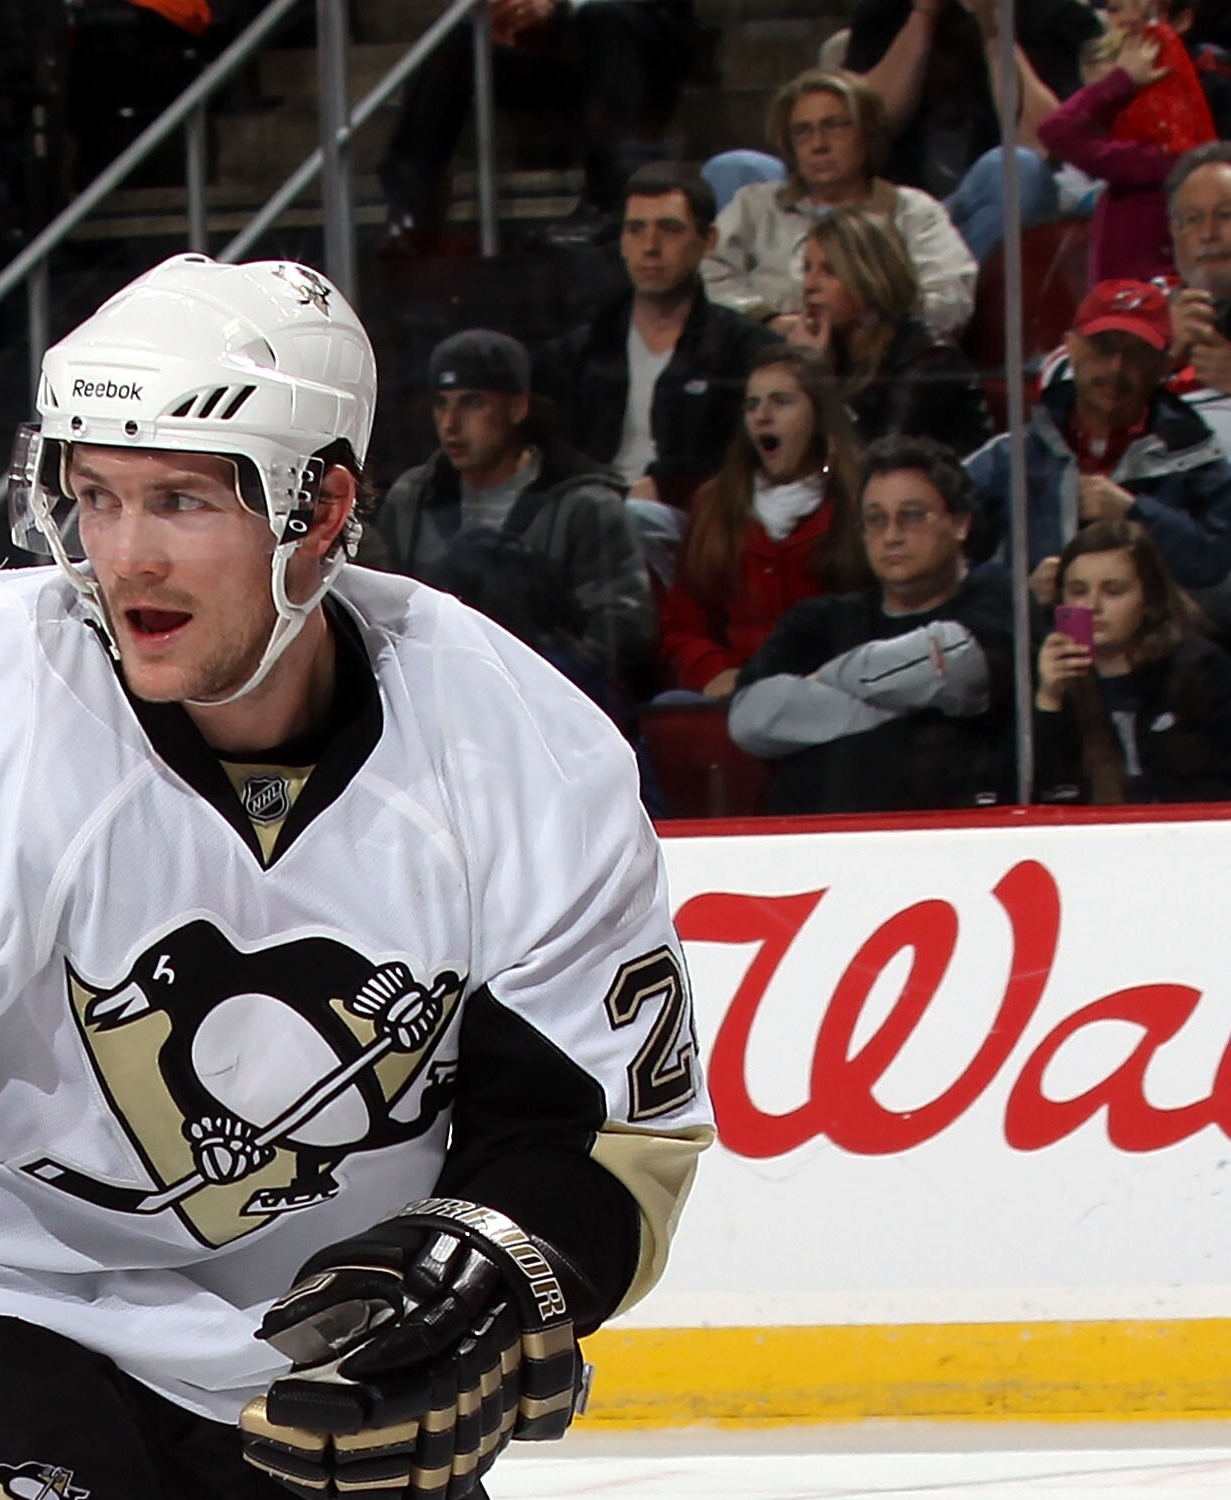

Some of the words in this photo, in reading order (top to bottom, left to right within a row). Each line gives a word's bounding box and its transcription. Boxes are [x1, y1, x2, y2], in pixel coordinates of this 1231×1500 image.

[72, 379, 143, 401] Reebok
[252, 785, 281, 812] NHL
[604, 944, 699, 1122] 2
[673, 860, 1231, 1159] Wa
